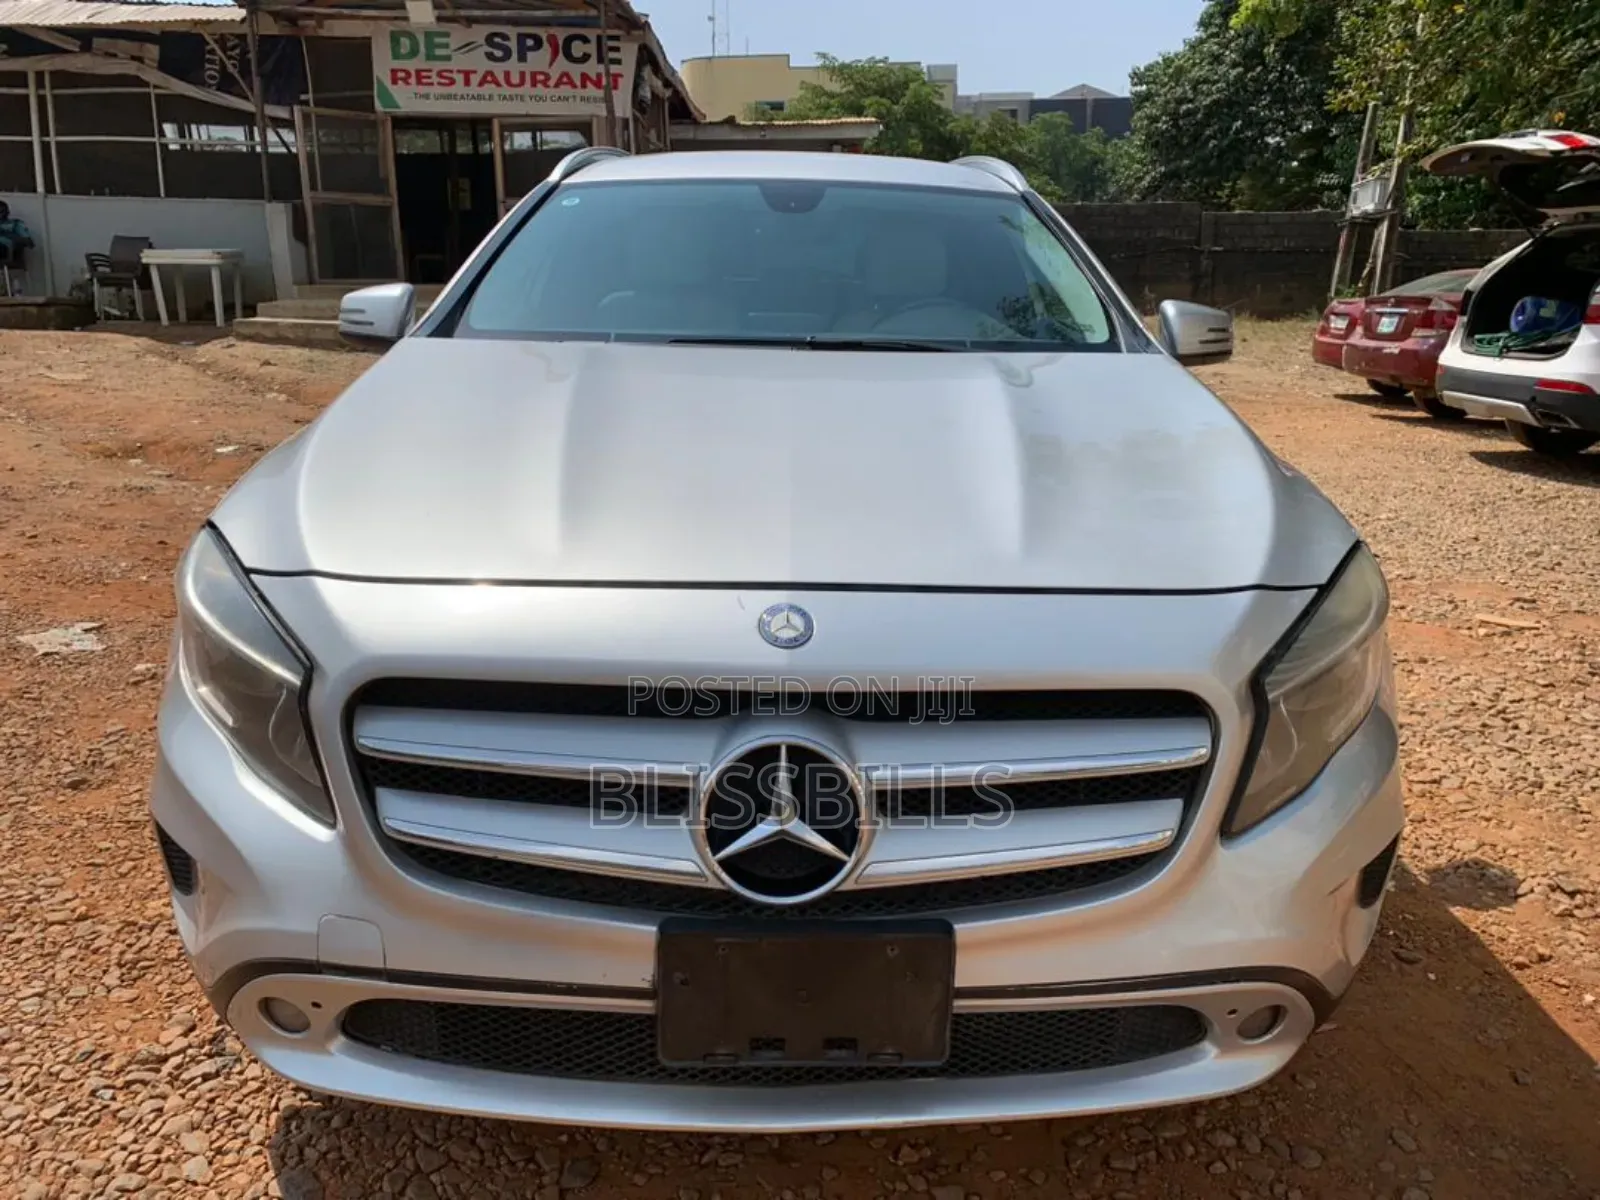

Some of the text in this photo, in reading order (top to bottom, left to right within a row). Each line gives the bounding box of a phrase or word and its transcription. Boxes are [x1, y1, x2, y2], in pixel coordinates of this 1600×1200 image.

[390, 68, 624, 91] RESTAURANT
[413, 92, 431, 101] THE
[433, 92, 493, 103] UNBEATABLE
[497, 94, 525, 103] TASTE
[528, 95, 548, 103] YOU
[550, 95, 577, 104] CAN'T
